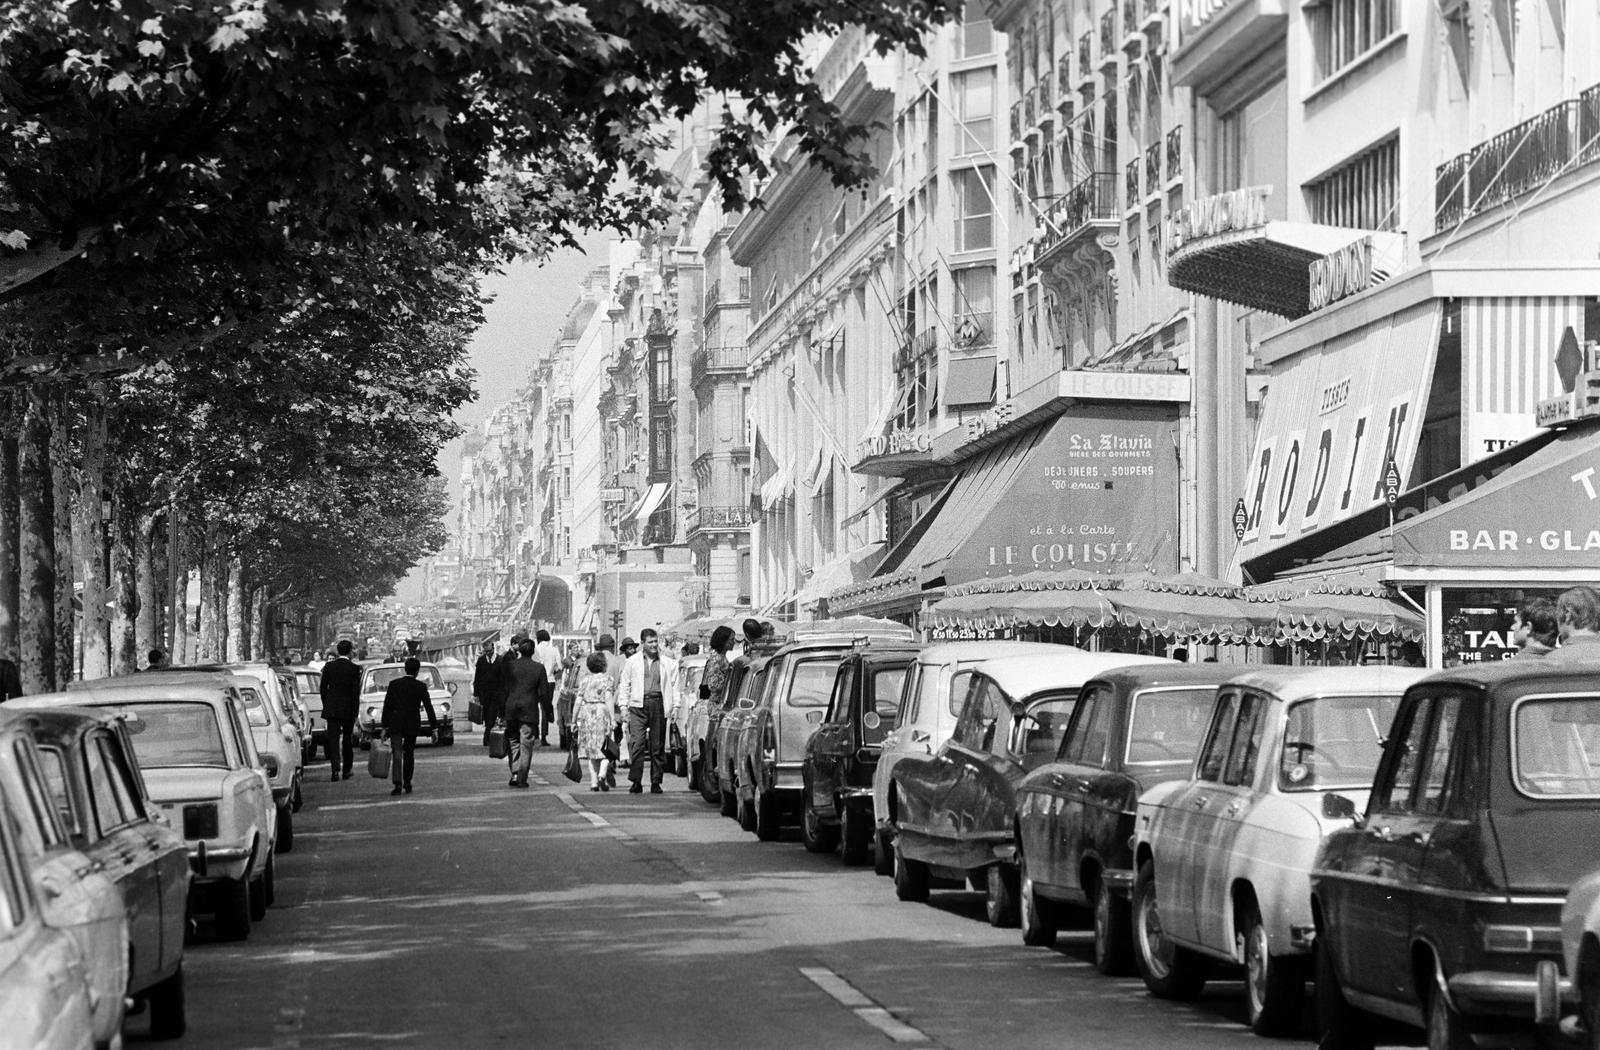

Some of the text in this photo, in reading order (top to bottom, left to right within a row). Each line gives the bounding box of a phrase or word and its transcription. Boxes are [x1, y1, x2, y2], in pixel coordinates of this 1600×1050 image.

[1072, 374, 1092, 394] LE
[1069, 433, 1153, 451] La Slavia
[1111, 465, 1154, 477] SOUPERS
[1246, 402, 1409, 532] RODIN
[1386, 460, 1398, 503] TABAC
[1079, 524, 1116, 535] Carte
[1235, 500, 1246, 538] TABAC
[1450, 529, 1518, 551] BAR
[989, 545, 1019, 566] LE
